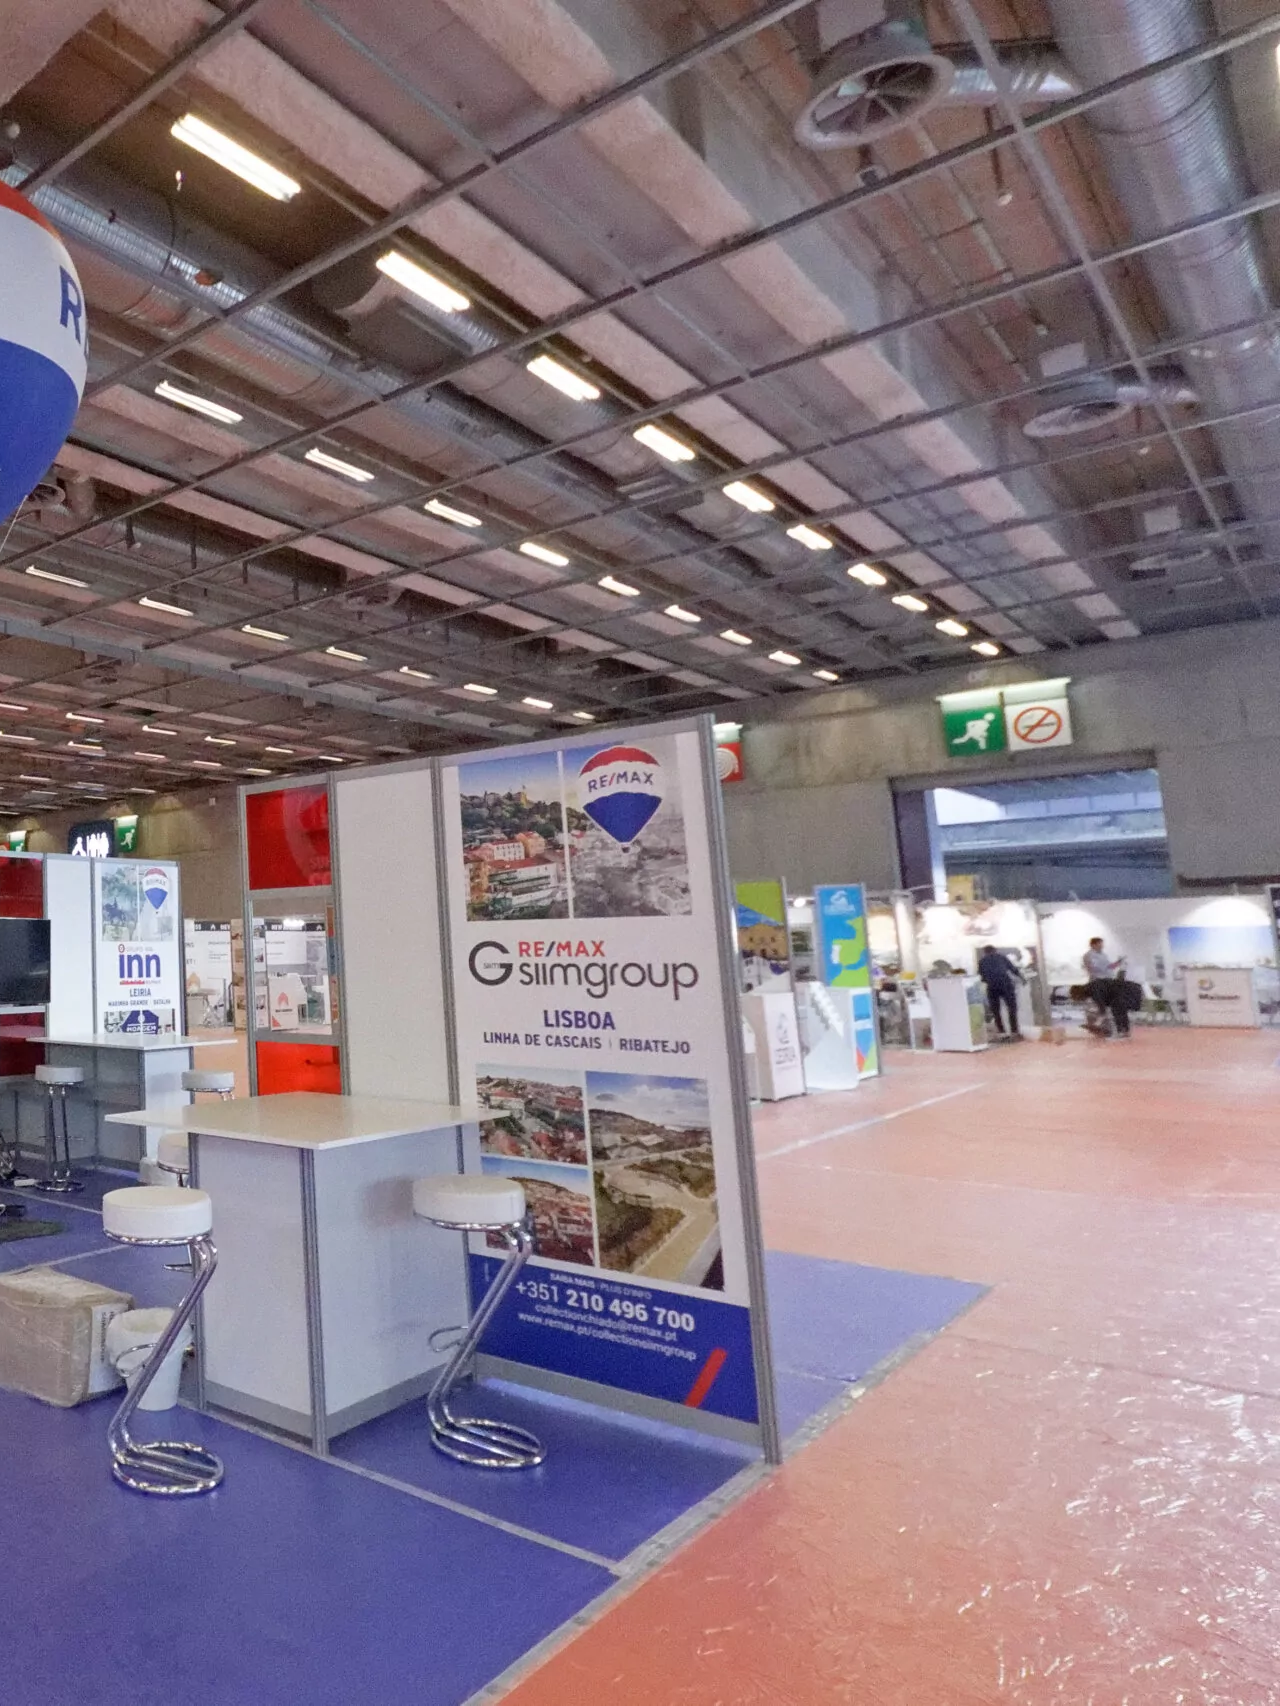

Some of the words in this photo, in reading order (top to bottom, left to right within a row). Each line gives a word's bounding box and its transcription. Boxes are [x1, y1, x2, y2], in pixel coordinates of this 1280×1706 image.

[587, 771, 654, 793] RE/MAX
[518, 940, 606, 958] RE/MAX
[519, 962, 699, 1001] siimgroup
[129, 988, 152, 998] LEIRIA
[543, 1009, 616, 1031] LISBOA
[483, 1032, 520, 1046] LINHA
[524, 1034, 541, 1047] DE
[545, 1035, 602, 1050] CASCAIS
[619, 1038, 691, 1055] RIBATEJO
[515, 1281, 559, 1303] +351
[566, 1289, 604, 1313] 210
[609, 1299, 649, 1323] 496
[653, 1306, 696, 1332] 700
